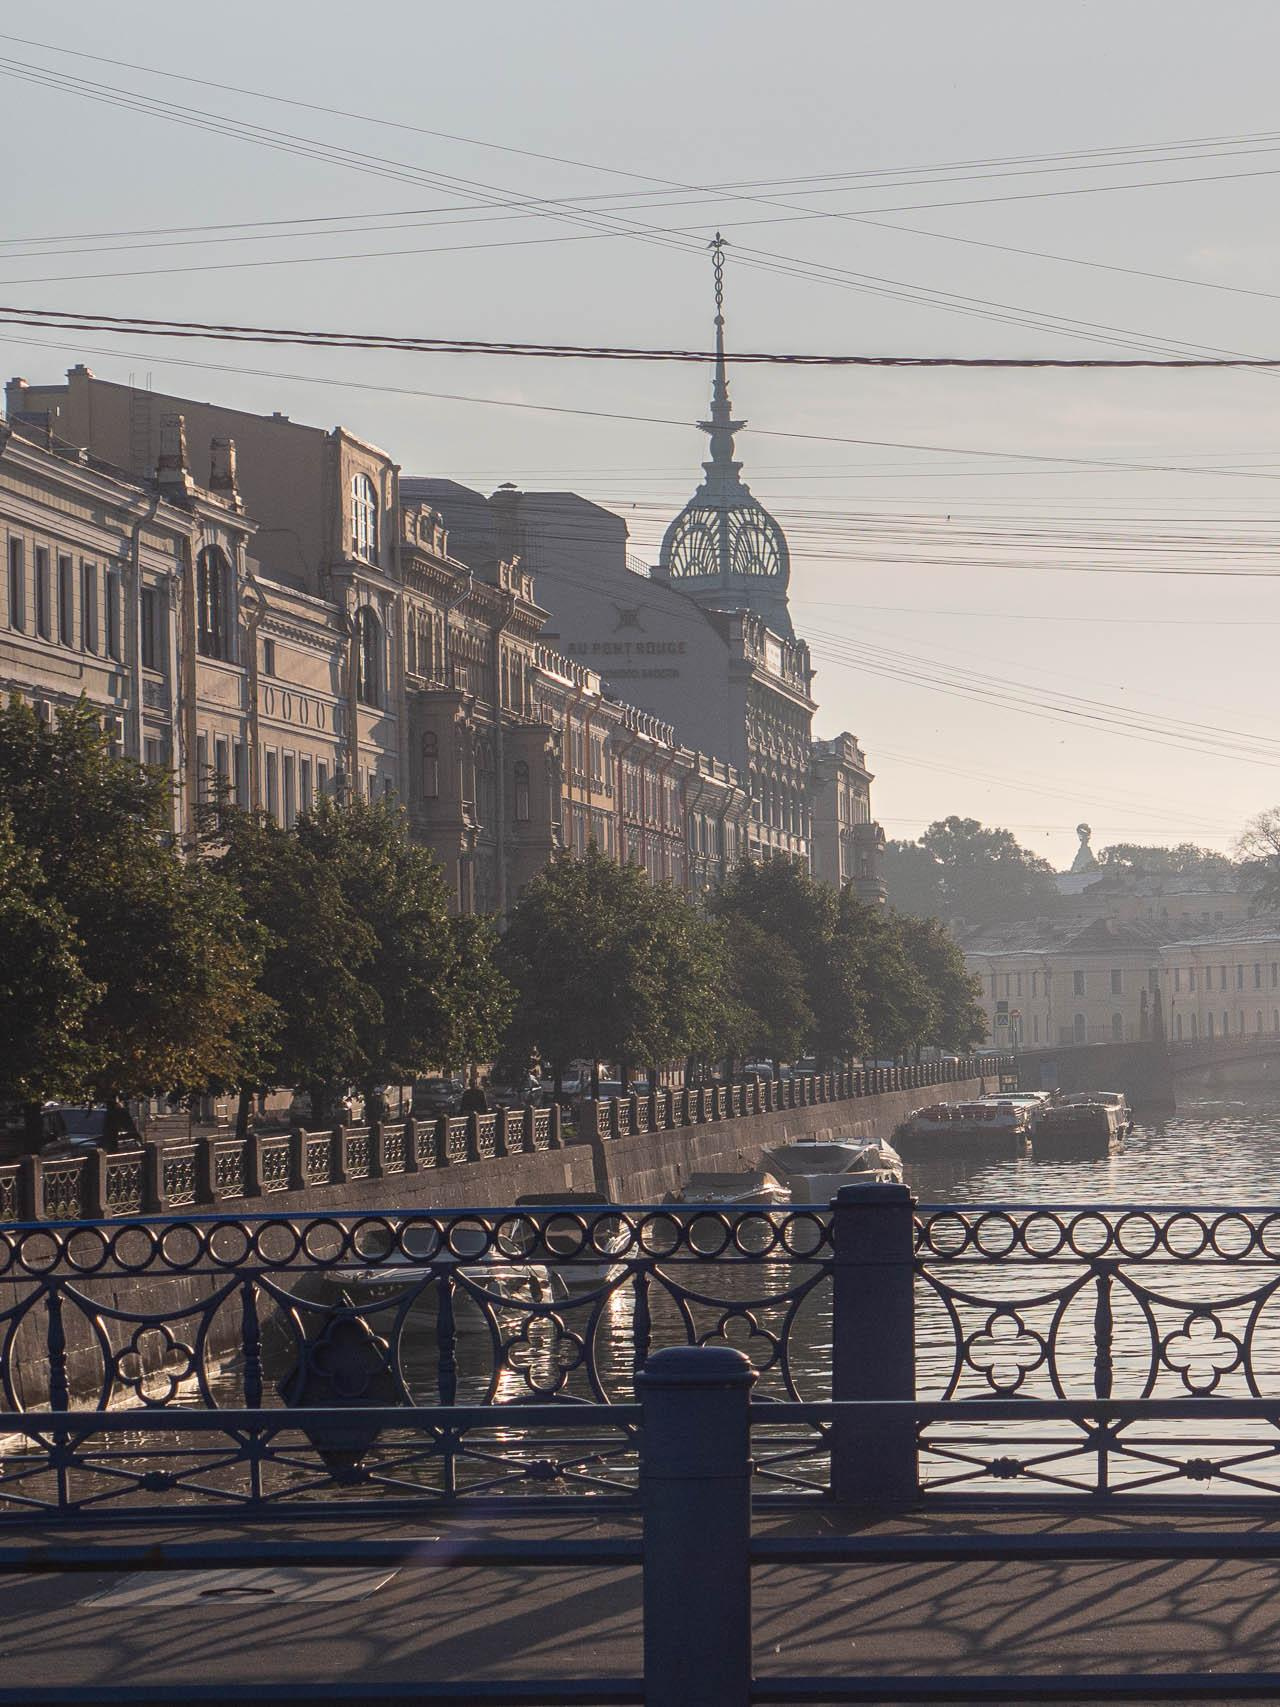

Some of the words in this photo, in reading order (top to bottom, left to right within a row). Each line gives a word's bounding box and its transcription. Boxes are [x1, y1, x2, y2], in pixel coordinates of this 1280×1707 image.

[567, 642, 587, 655] AU
[592, 642, 632, 655] PONT
[636, 642, 687, 655] ROUGE
